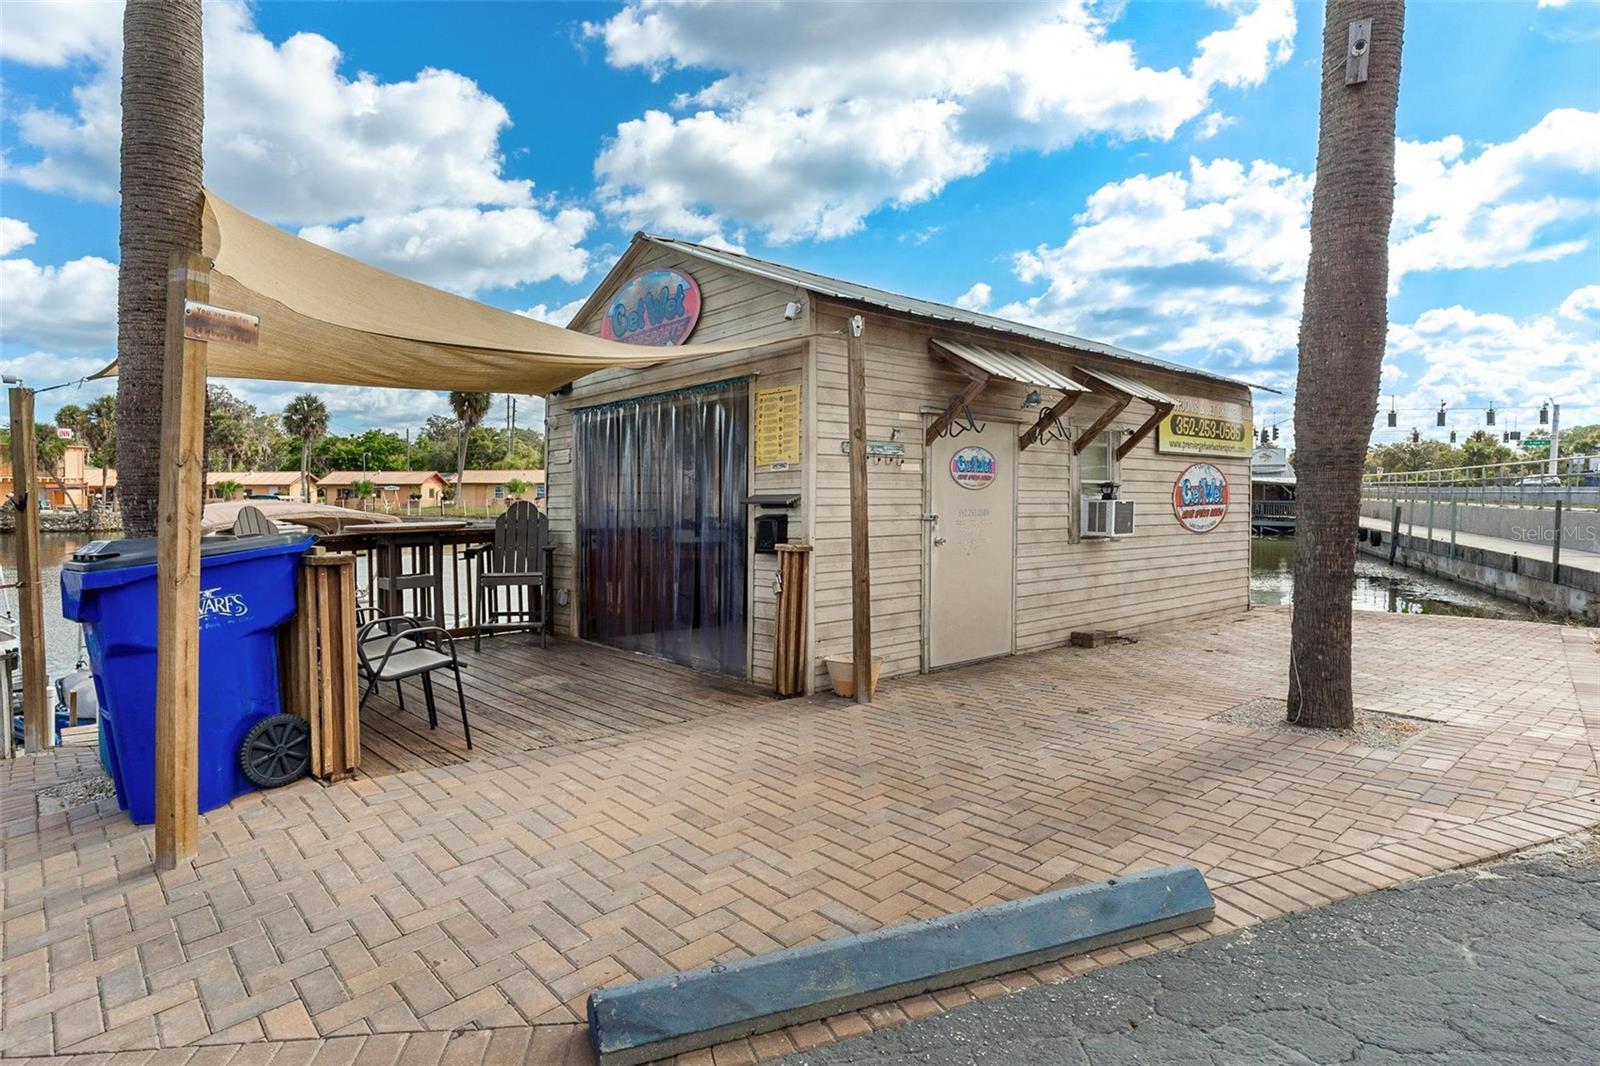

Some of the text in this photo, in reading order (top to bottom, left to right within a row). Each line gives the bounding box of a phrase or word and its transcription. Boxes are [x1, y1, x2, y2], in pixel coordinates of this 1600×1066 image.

[612, 283, 685, 338] Get Wet
[1175, 416, 1241, 440] 352-253-0585
[1182, 477, 1224, 505] Get Wet
